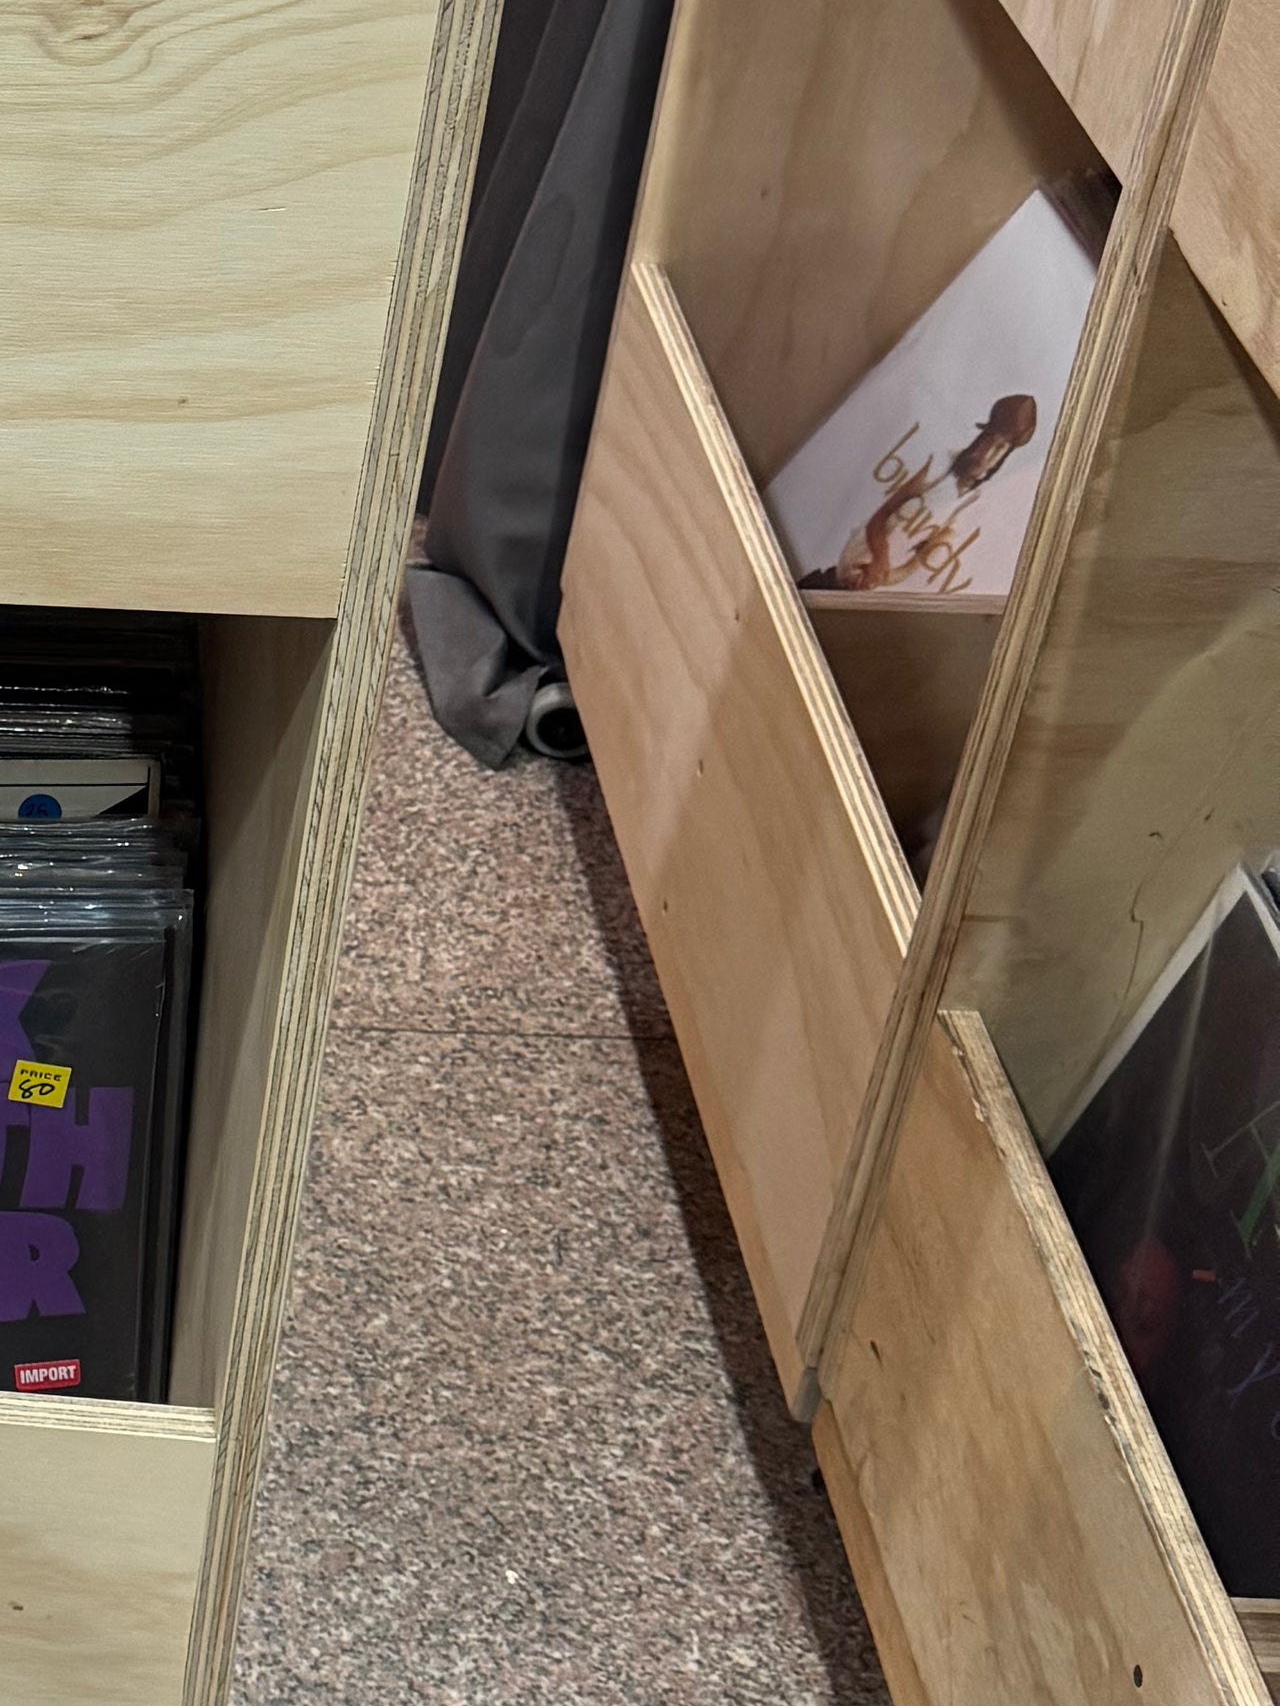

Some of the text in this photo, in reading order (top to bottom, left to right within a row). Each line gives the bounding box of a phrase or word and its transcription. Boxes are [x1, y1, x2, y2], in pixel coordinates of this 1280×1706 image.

[20, 1068, 63, 1082] PRICE
[18, 1078, 56, 1099] 80
[19, 1365, 78, 1386] IMPORT
